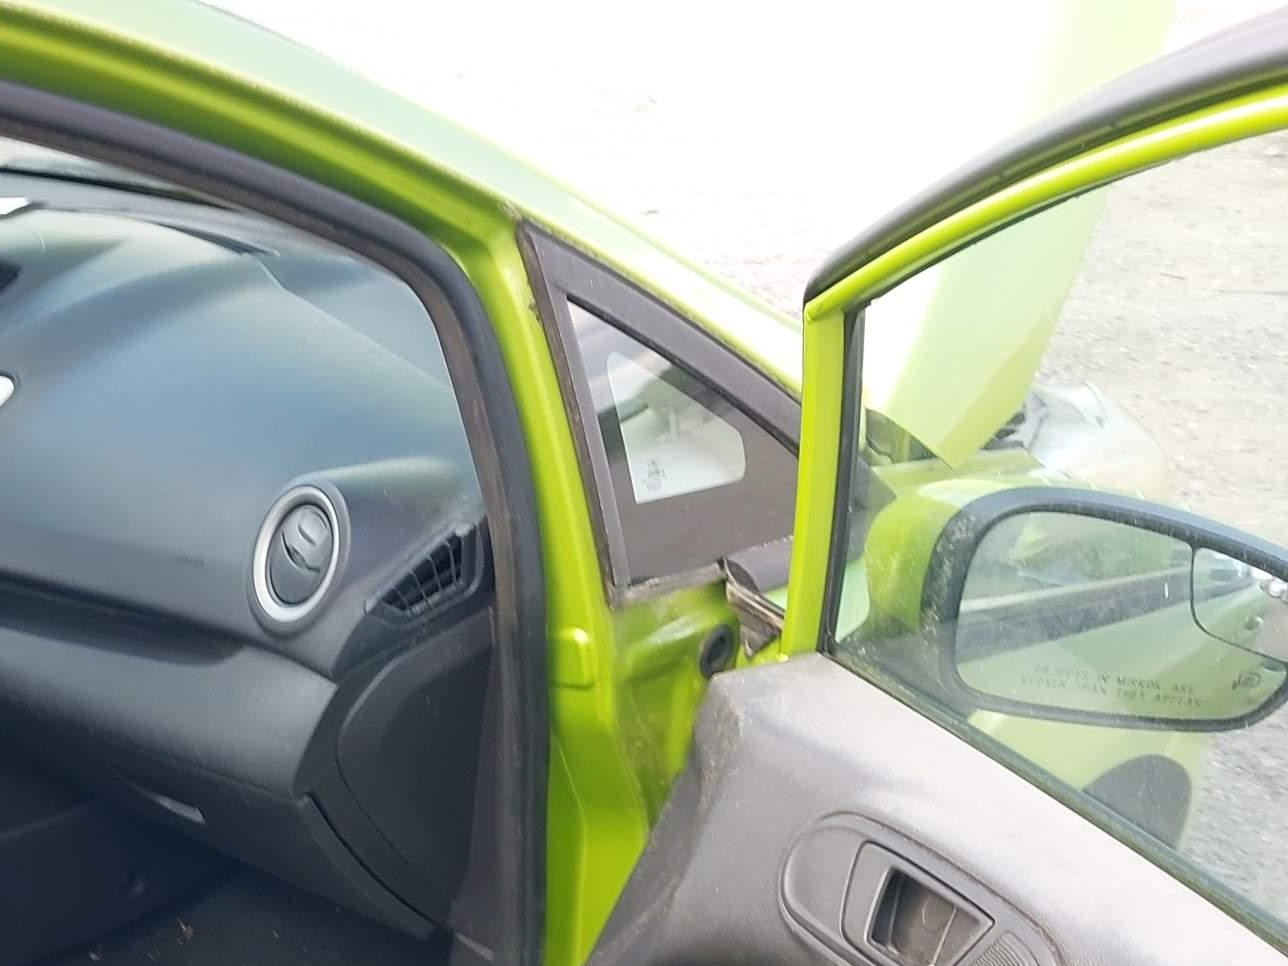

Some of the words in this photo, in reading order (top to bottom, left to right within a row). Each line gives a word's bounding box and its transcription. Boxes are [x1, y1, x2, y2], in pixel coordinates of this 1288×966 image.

[1020, 675, 1067, 690] CLOSER
[1077, 682, 1107, 696] THAN
[1117, 688, 1145, 699] THEY
[1154, 693, 1202, 707] APPEAR
[1117, 675, 1161, 690] MIRROR
[1174, 683, 1195, 695] ARE
